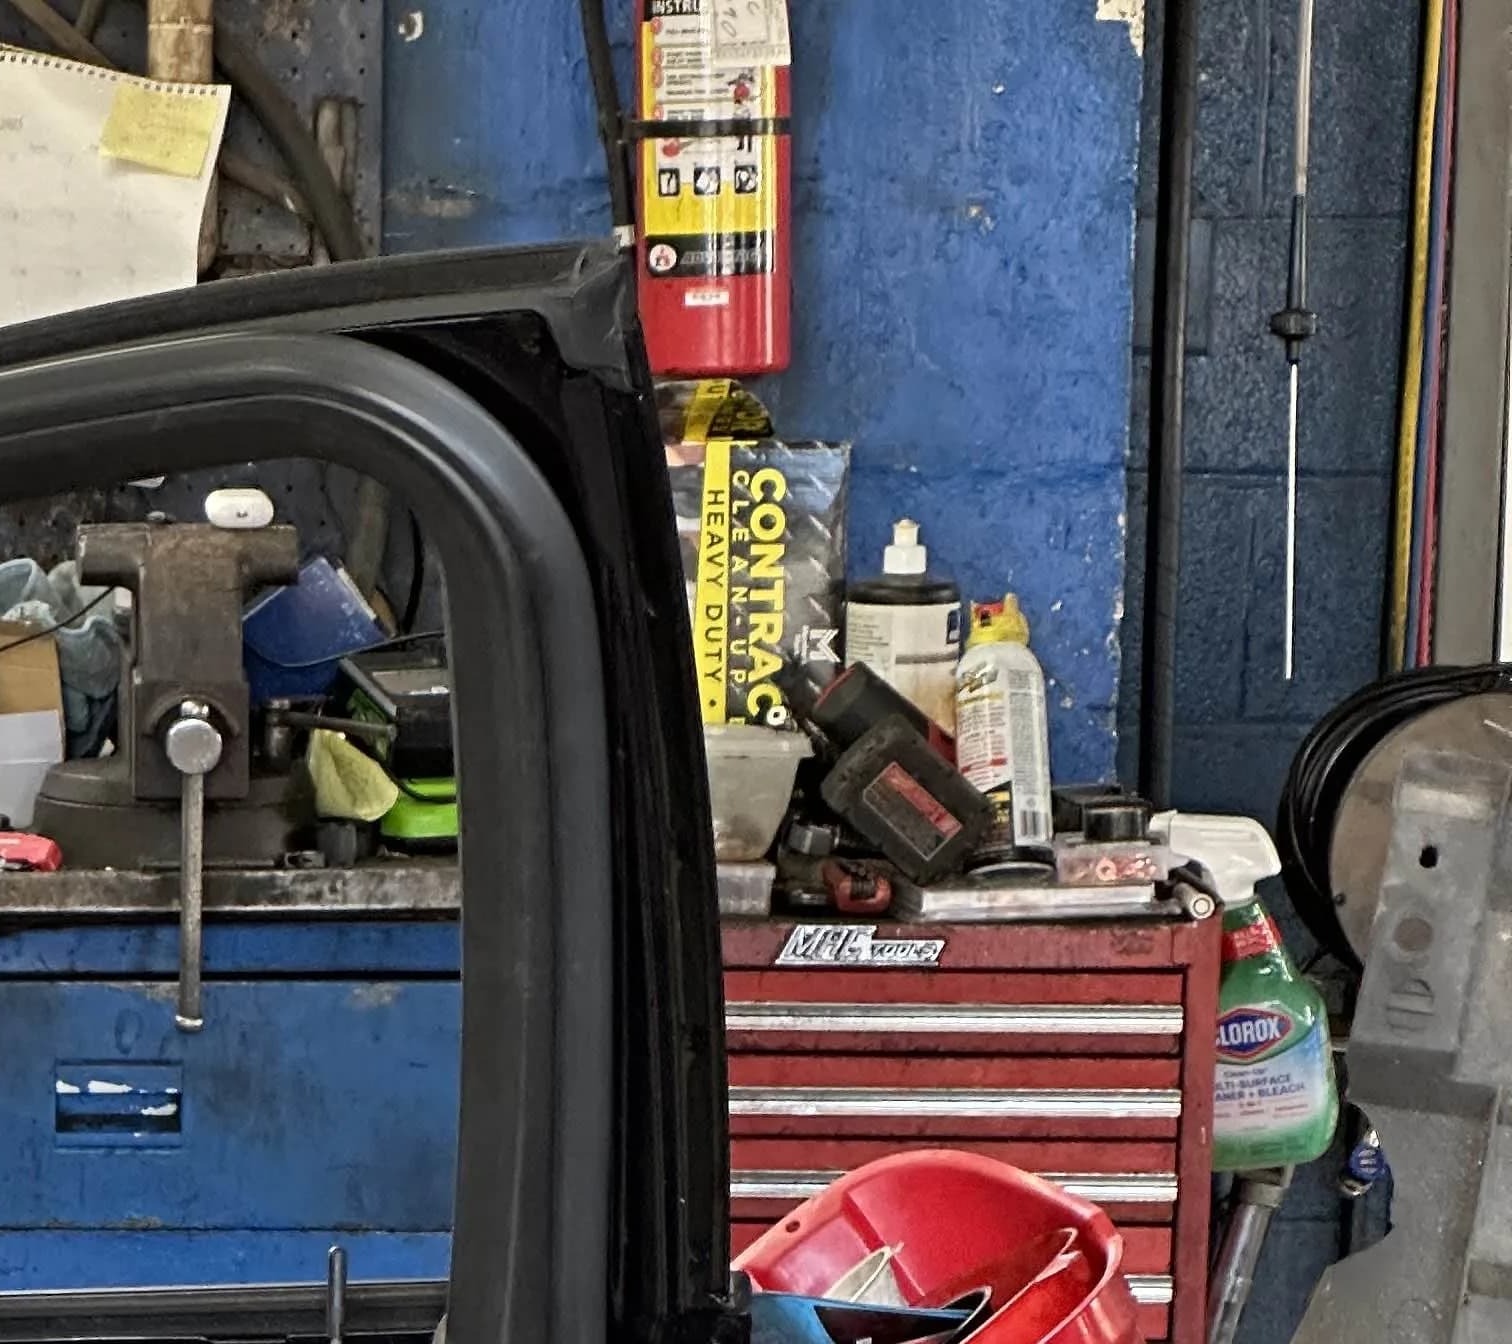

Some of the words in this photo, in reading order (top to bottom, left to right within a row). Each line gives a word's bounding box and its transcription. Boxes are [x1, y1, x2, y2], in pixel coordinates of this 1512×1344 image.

[705, 489, 725, 588] HEAVY
[729, 470, 750, 684] CLEAN-UP
[704, 604, 724, 682] DUTY
[1216, 1016, 1282, 1047] LOROX
[1257, 1081, 1304, 1098] BLEACH
